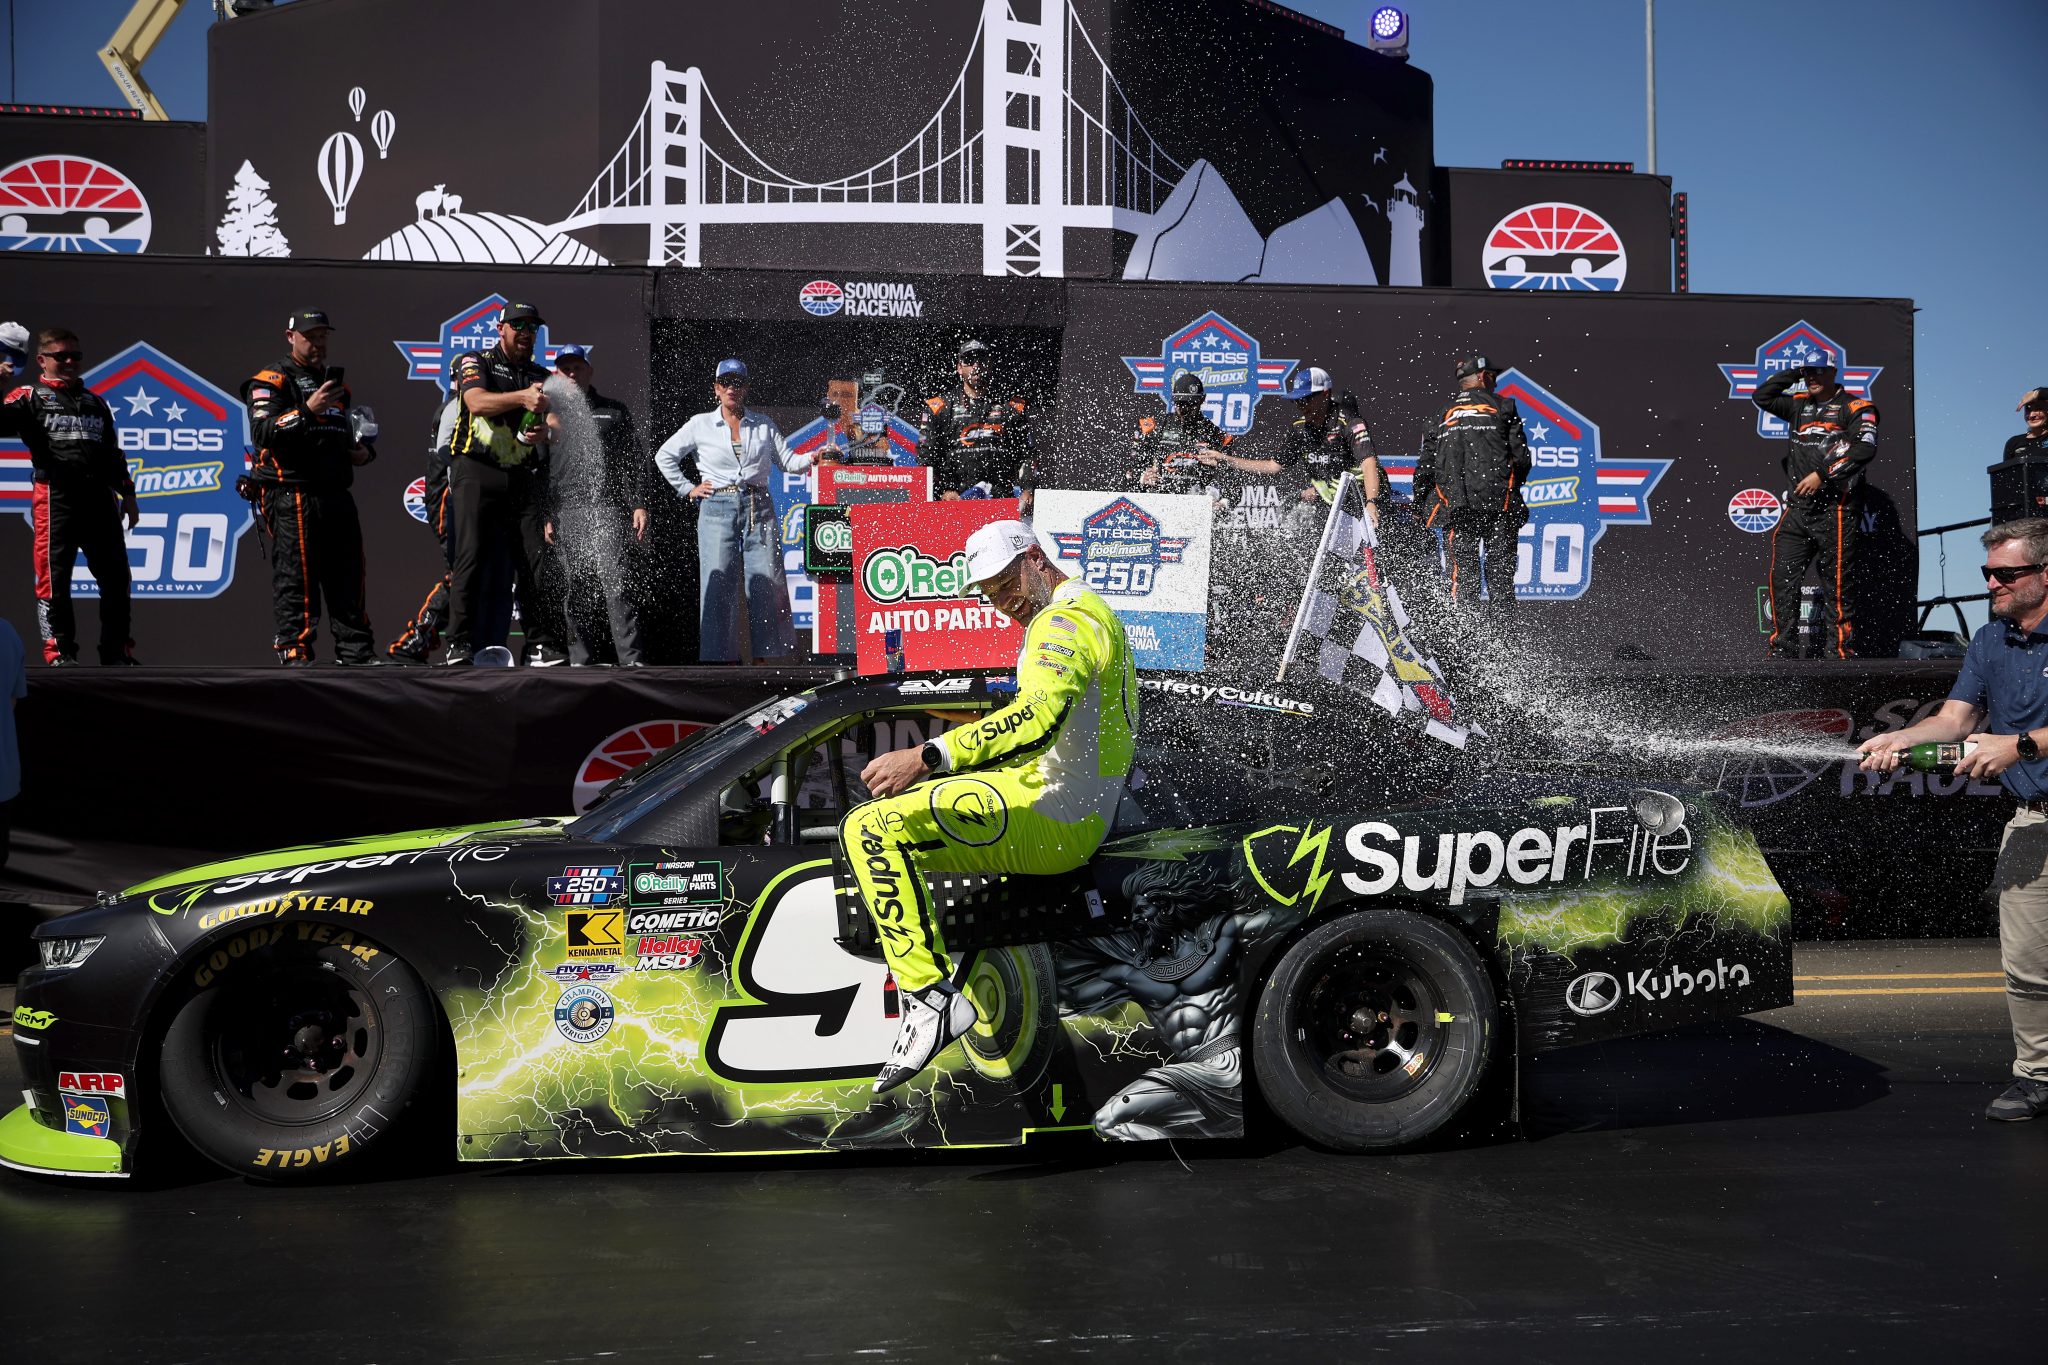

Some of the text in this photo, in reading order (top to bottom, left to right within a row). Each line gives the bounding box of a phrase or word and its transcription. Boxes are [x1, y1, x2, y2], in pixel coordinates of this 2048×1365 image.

[844, 282, 916, 300] SONOMA
[844, 299, 923, 317] RACEWAY
[450, 336, 481, 349] PIT
[1171, 352, 1249, 364] PIT BOSS
[1764, 359, 1789, 370] PIT
[117, 428, 223, 451] BOSS
[834, 472, 913, 483] O'Reilly AUTO PARTS
[1088, 527, 1153, 540] PIT BOSS
[1085, 561, 1155, 591] 250
[137, 583, 204, 591] RACEWAY
[869, 606, 1012, 633] AUTO PARTS
[1046, 643, 1074, 656] NASCAR
[1037, 660, 1069, 672] SUNOCO
[1340, 806, 1692, 906] SuperFile
[664, 861, 695, 870] NASCAR
[565, 876, 607, 893] 250
[637, 873, 715, 892] O'Reilly AUTO
[689, 881, 717, 891] PARTS
[663, 896, 688, 905] SERIES
[630, 909, 720, 931] COMETIC
[568, 947, 622, 957] KENNAMETAL
[637, 936, 702, 958] Holley
[555, 964, 615, 975] FIVE STAR
[636, 955, 693, 971] MSD
[1627, 958, 1751, 1001] Kubota
[561, 988, 607, 1007] CHAMPION
[14, 1012, 48, 1027] JRM
[560, 1020, 610, 1041] IRRIGATION
[59, 1072, 124, 1092] ARP
[69, 1108, 107, 1123] SUNOCO
[252, 1133, 351, 1168] EAGLE
